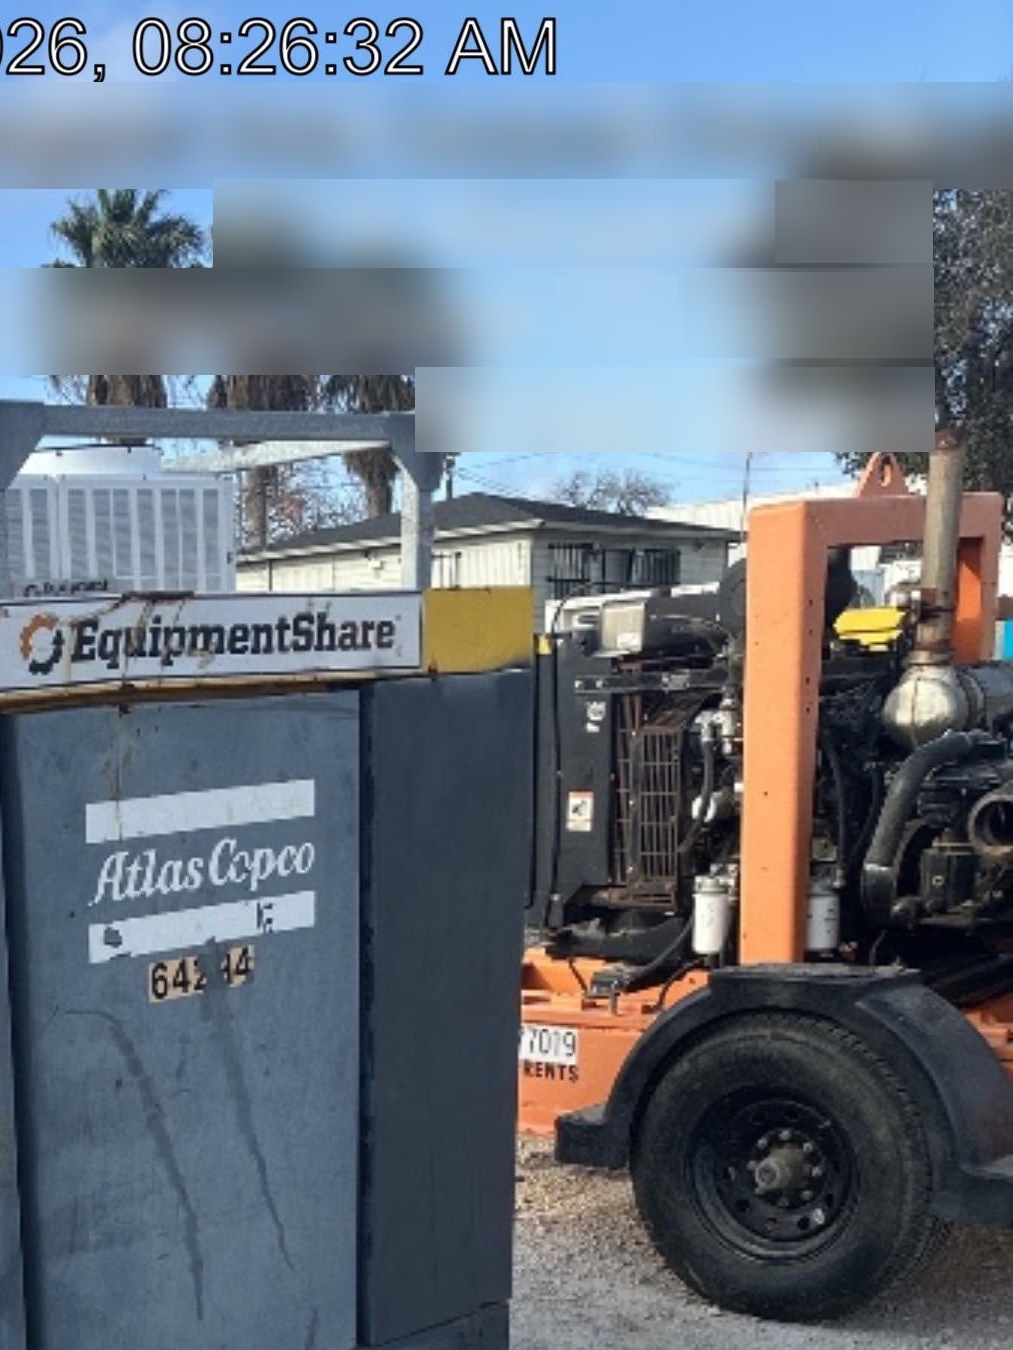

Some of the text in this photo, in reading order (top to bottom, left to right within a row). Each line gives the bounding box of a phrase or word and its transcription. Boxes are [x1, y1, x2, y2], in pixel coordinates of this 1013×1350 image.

[71, 612, 396, 670] EquipmentShare
[88, 837, 315, 907] Atlas Copco
